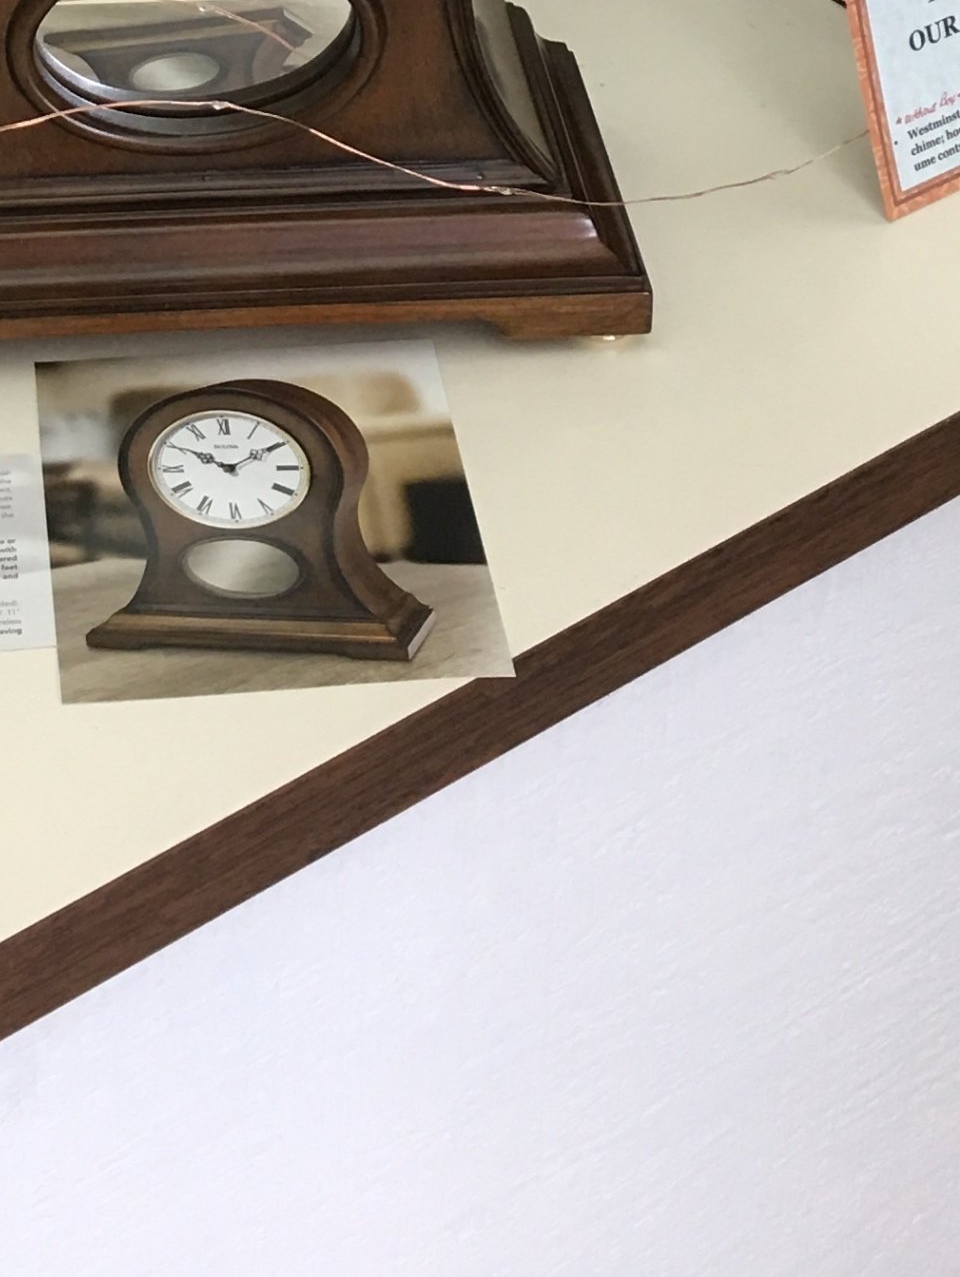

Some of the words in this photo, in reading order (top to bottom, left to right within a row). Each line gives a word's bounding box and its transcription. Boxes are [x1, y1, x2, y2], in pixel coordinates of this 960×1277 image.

[907, 110, 960, 139] Westminst
[911, 135, 945, 156] chime;
[914, 156, 936, 172] ume
